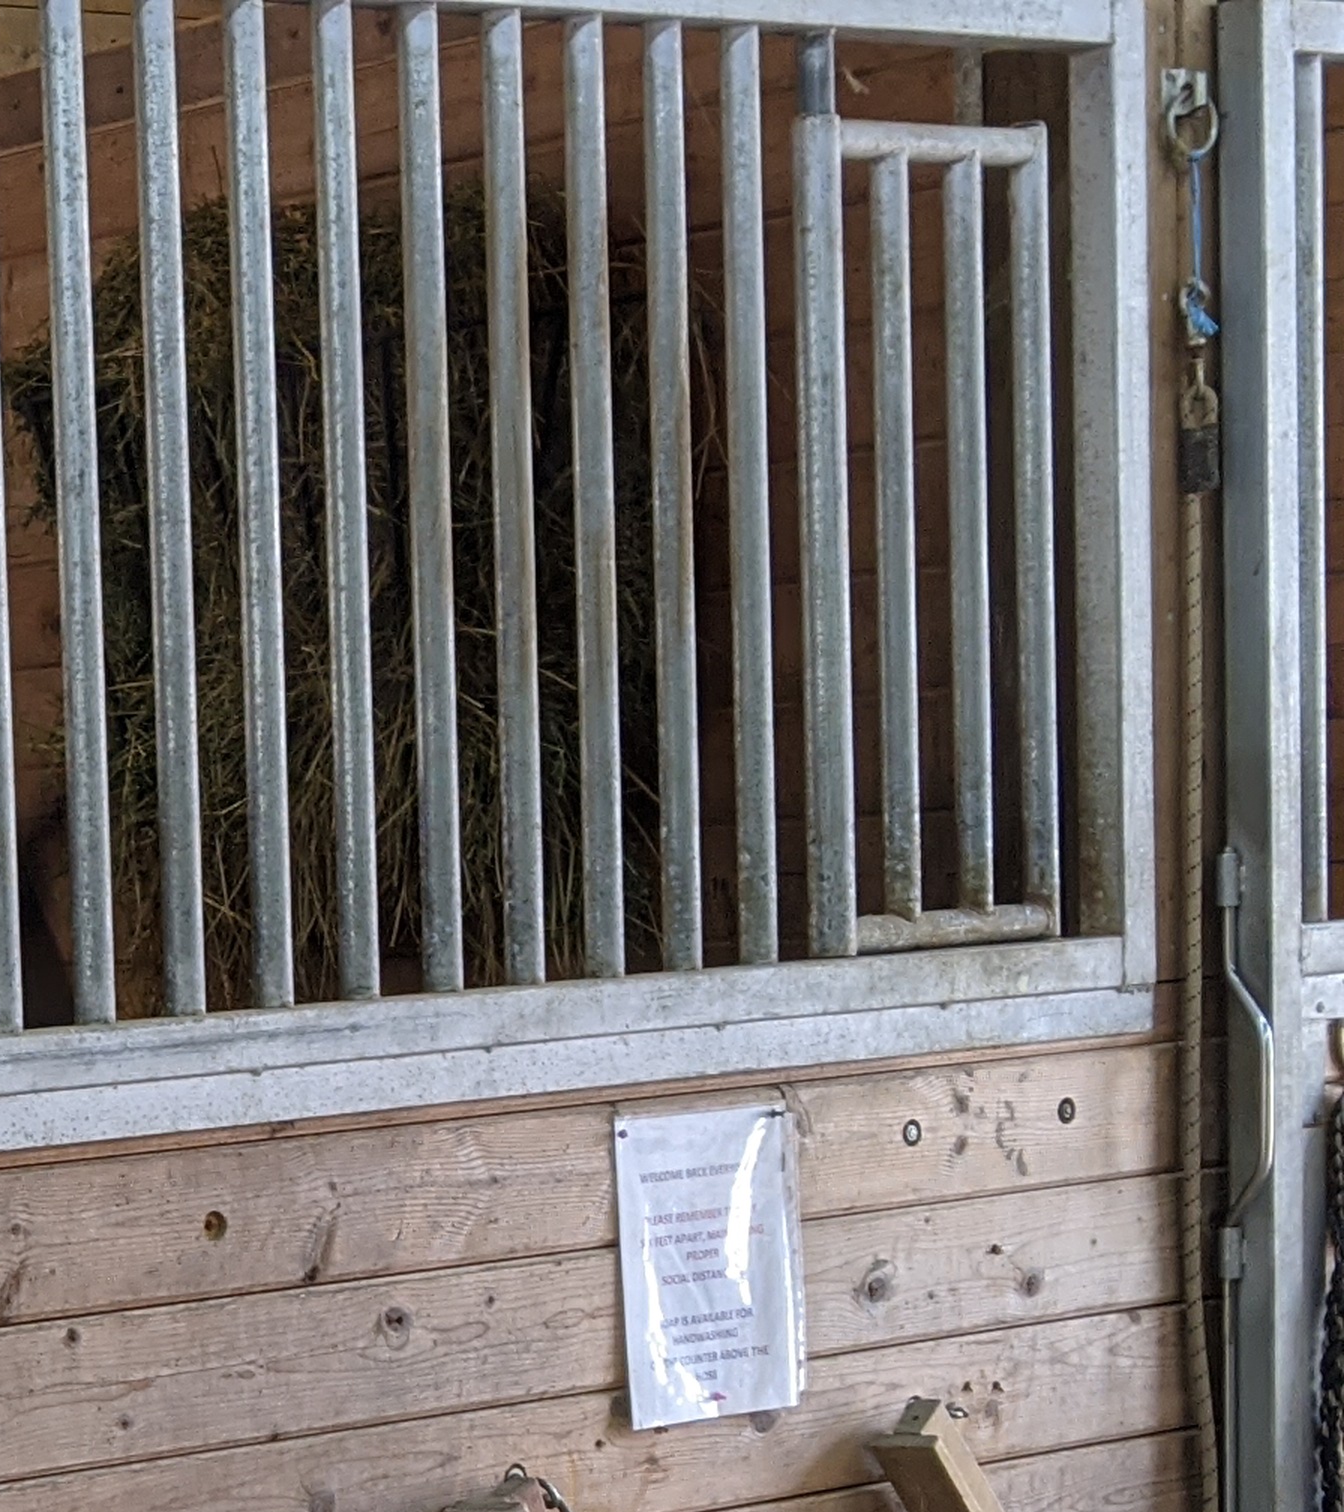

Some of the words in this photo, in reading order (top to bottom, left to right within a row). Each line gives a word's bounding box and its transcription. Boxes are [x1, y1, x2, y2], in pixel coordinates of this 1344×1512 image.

[639, 1170, 684, 1184] WELCOME
[686, 1167, 708, 1179] BACK
[687, 1248, 720, 1261] PROPER
[662, 1274, 691, 1287] SOCIAL
[660, 1317, 680, 1329] OAP
[691, 1310, 734, 1324] AVAILABLE
[736, 1307, 754, 1319] FOR
